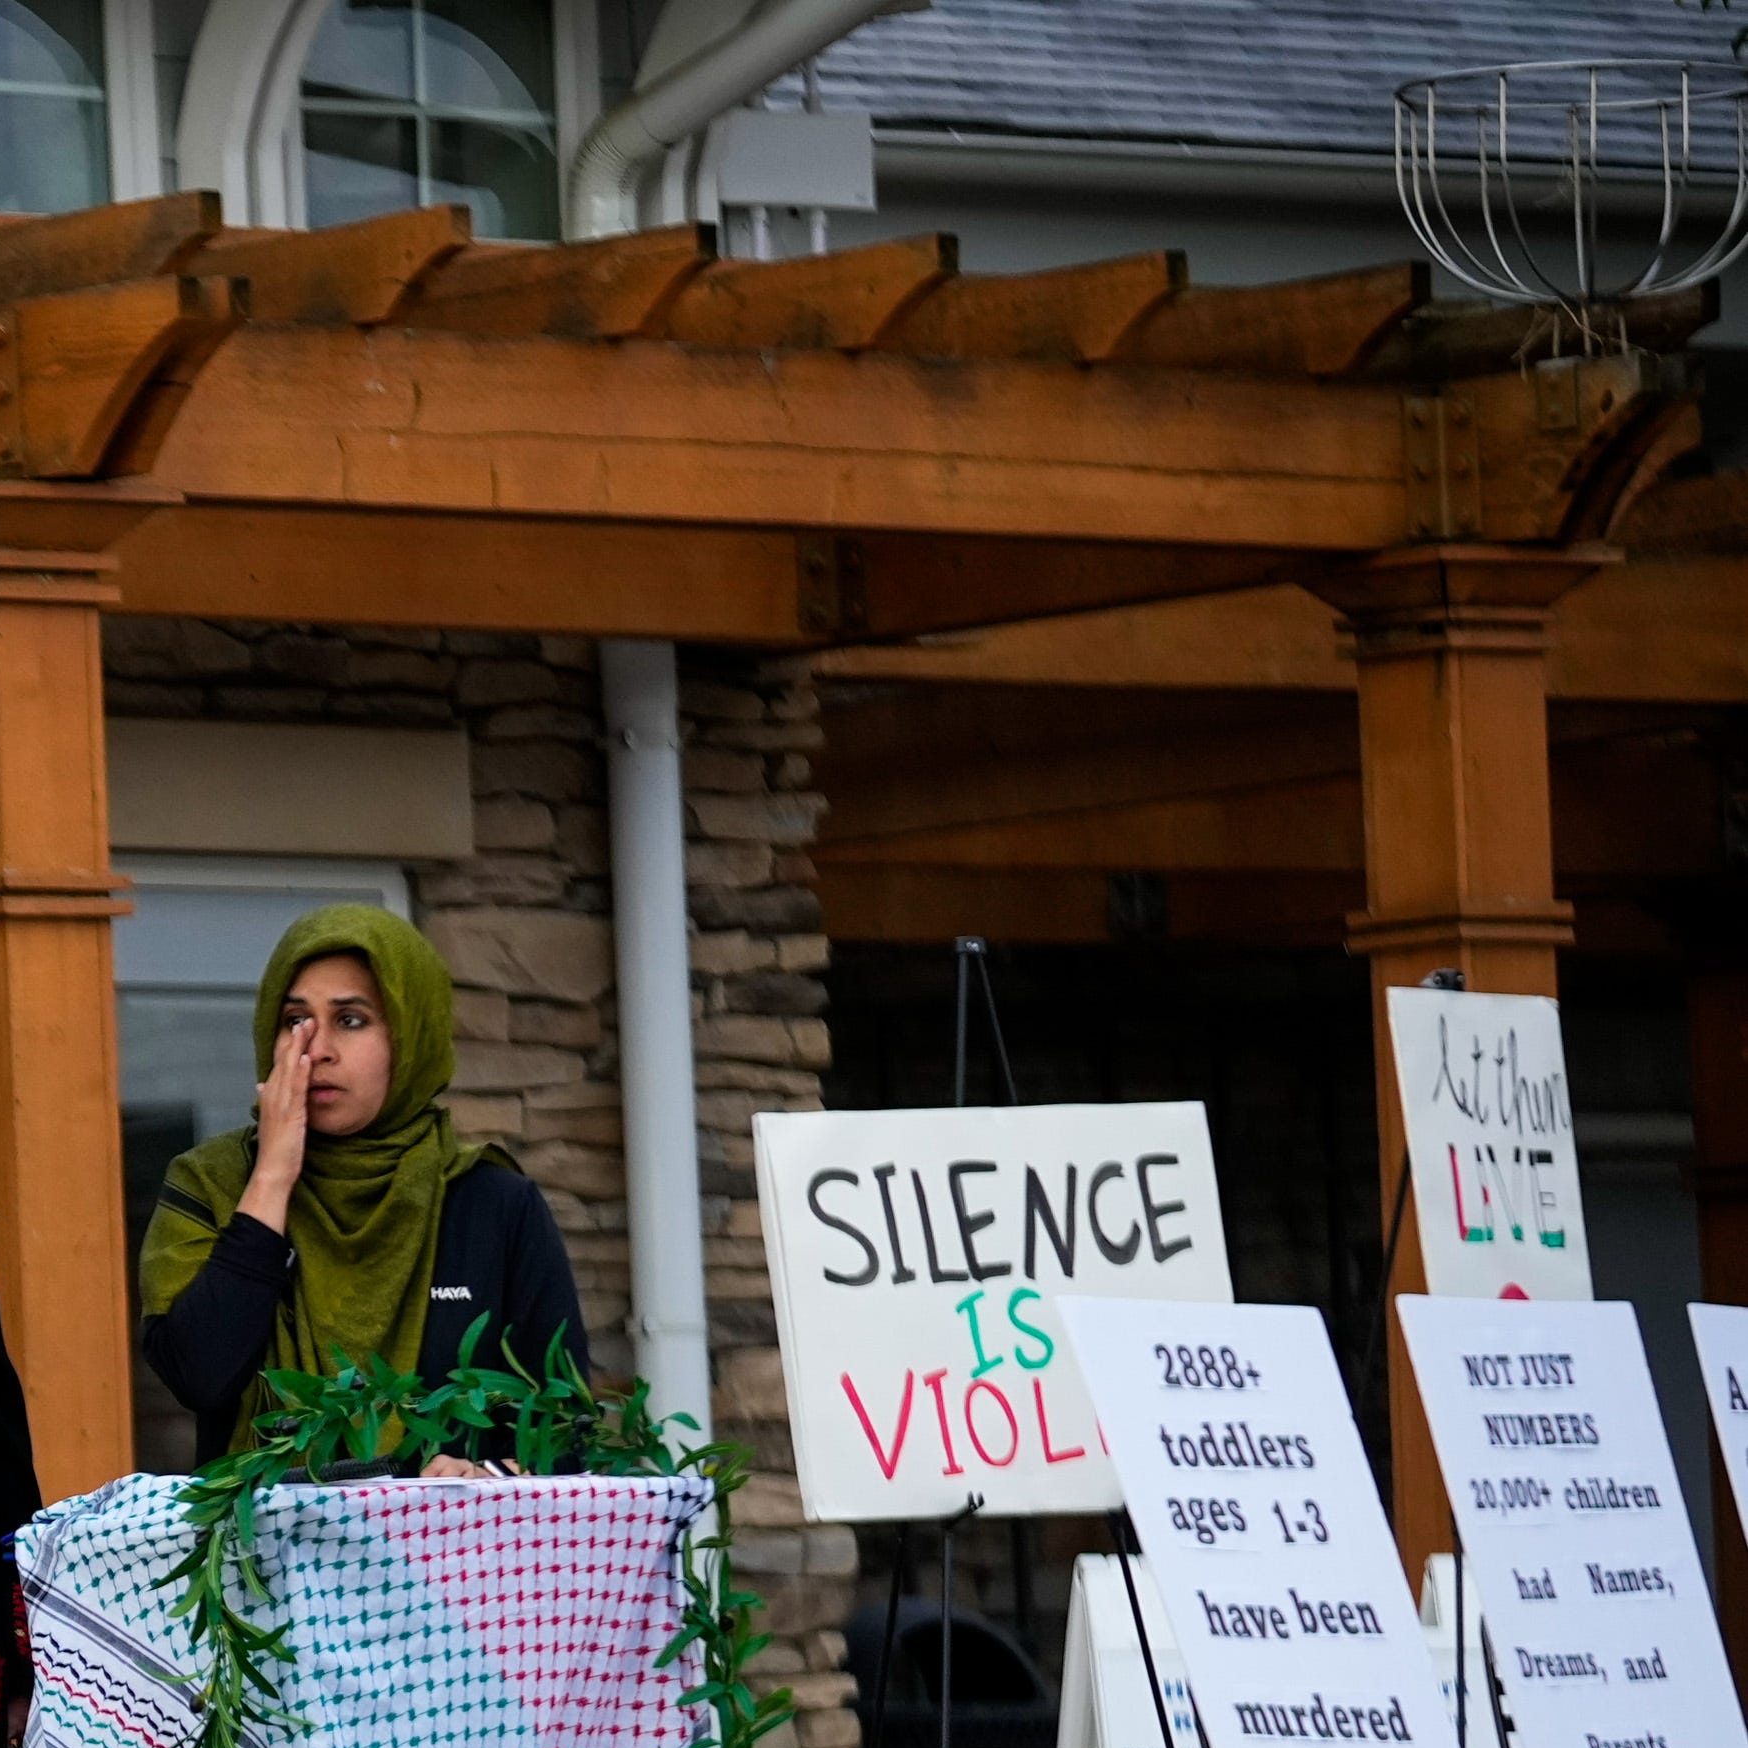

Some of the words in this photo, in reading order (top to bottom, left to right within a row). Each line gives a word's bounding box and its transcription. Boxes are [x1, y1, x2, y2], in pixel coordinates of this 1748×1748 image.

[807, 1153, 1193, 1286] SILENCE
[955, 1287, 1054, 1379] IS
[1154, 1344, 1262, 1388] 2888+
[1462, 1354, 1513, 1387] NOT
[1519, 1353, 1575, 1385] JUST
[840, 1367, 1110, 1480] VIOL
[1160, 1422, 1316, 1468] toddlers
[1483, 1413, 1600, 1445] NUMBERS
[1564, 1477, 1662, 1510] children
[1167, 1498, 1247, 1545] ages
[1272, 1499, 1329, 1543] 1-3
[1512, 1567, 1557, 1600] had
[1585, 1563, 1675, 1599] Names,
[1197, 1589, 1290, 1640] have
[1288, 1587, 1385, 1635] been
[1515, 1647, 1607, 1684] Dreams,
[1623, 1647, 1668, 1680] and
[1235, 1693, 1413, 1741] murdered
